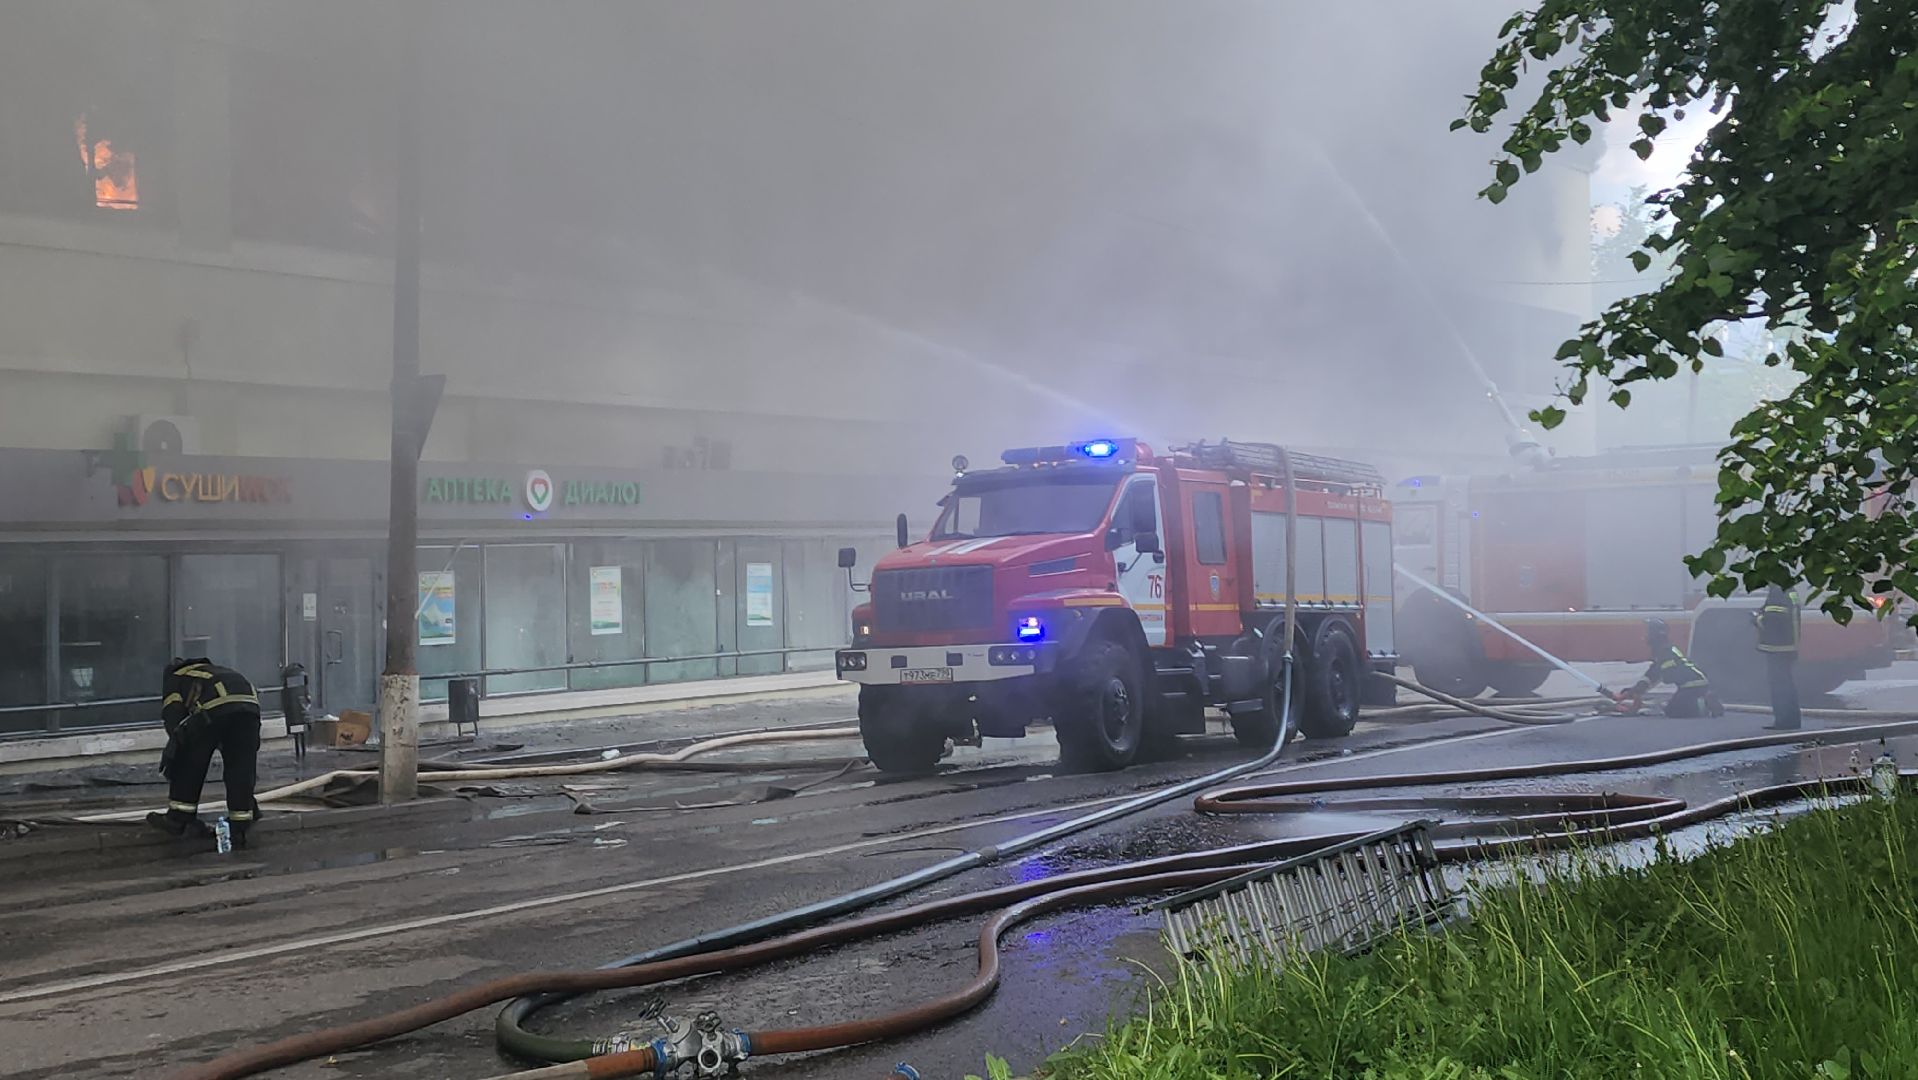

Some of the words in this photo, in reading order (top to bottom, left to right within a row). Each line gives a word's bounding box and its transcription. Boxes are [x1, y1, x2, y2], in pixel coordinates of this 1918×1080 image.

[427, 478, 512, 502] АПТЕКА
[901, 589, 952, 601] URAL
[1147, 574, 1162, 599] 76
